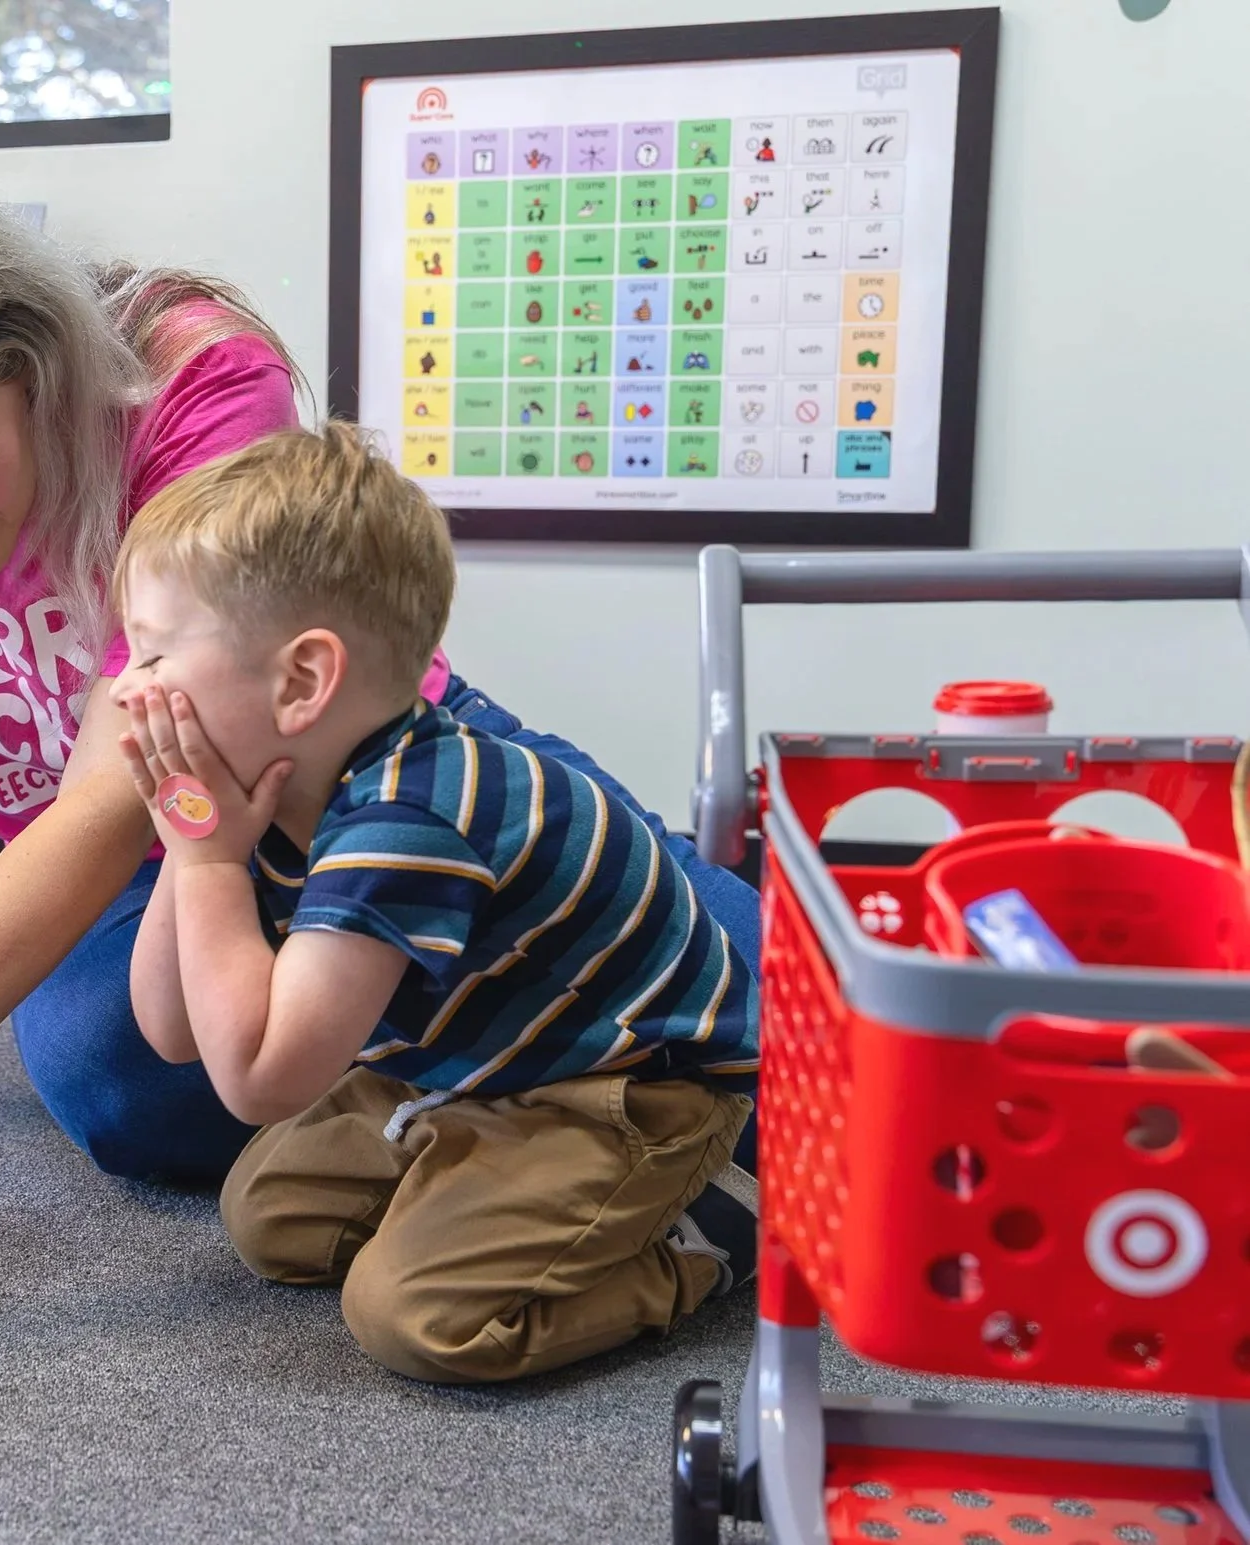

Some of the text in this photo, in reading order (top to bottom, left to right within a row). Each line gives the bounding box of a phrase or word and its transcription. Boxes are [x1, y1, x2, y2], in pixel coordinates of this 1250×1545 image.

[861, 68, 902, 88] Grid
[807, 118, 834, 128] then
[862, 114, 897, 127] again
[633, 125, 664, 135] when
[692, 123, 717, 133] wait
[750, 122, 773, 131] now
[575, 128, 609, 138] where
[806, 172, 830, 182] that
[864, 169, 890, 179] here
[576, 181, 606, 190] come
[693, 178, 712, 188] say
[807, 226, 824, 235] on
[865, 222, 883, 234] off
[680, 228, 721, 239] choose
[688, 280, 709, 290] feel
[859, 277, 884, 287] time
[579, 283, 598, 295] get
[628, 282, 658, 293] good
[803, 292, 822, 303] the
[574, 334, 599, 344] help
[627, 334, 656, 342] more
[852, 330, 886, 340] place
[741, 346, 765, 355] and
[798, 345, 823, 355] with
[574, 384, 597, 394] hurt
[617, 383, 662, 393] different
[679, 384, 710, 393] make
[736, 384, 767, 393] some
[798, 383, 818, 392] not
[852, 382, 882, 394] thing
[624, 435, 653, 444] same
[681, 435, 705, 445] play
[799, 435, 814, 445] up
